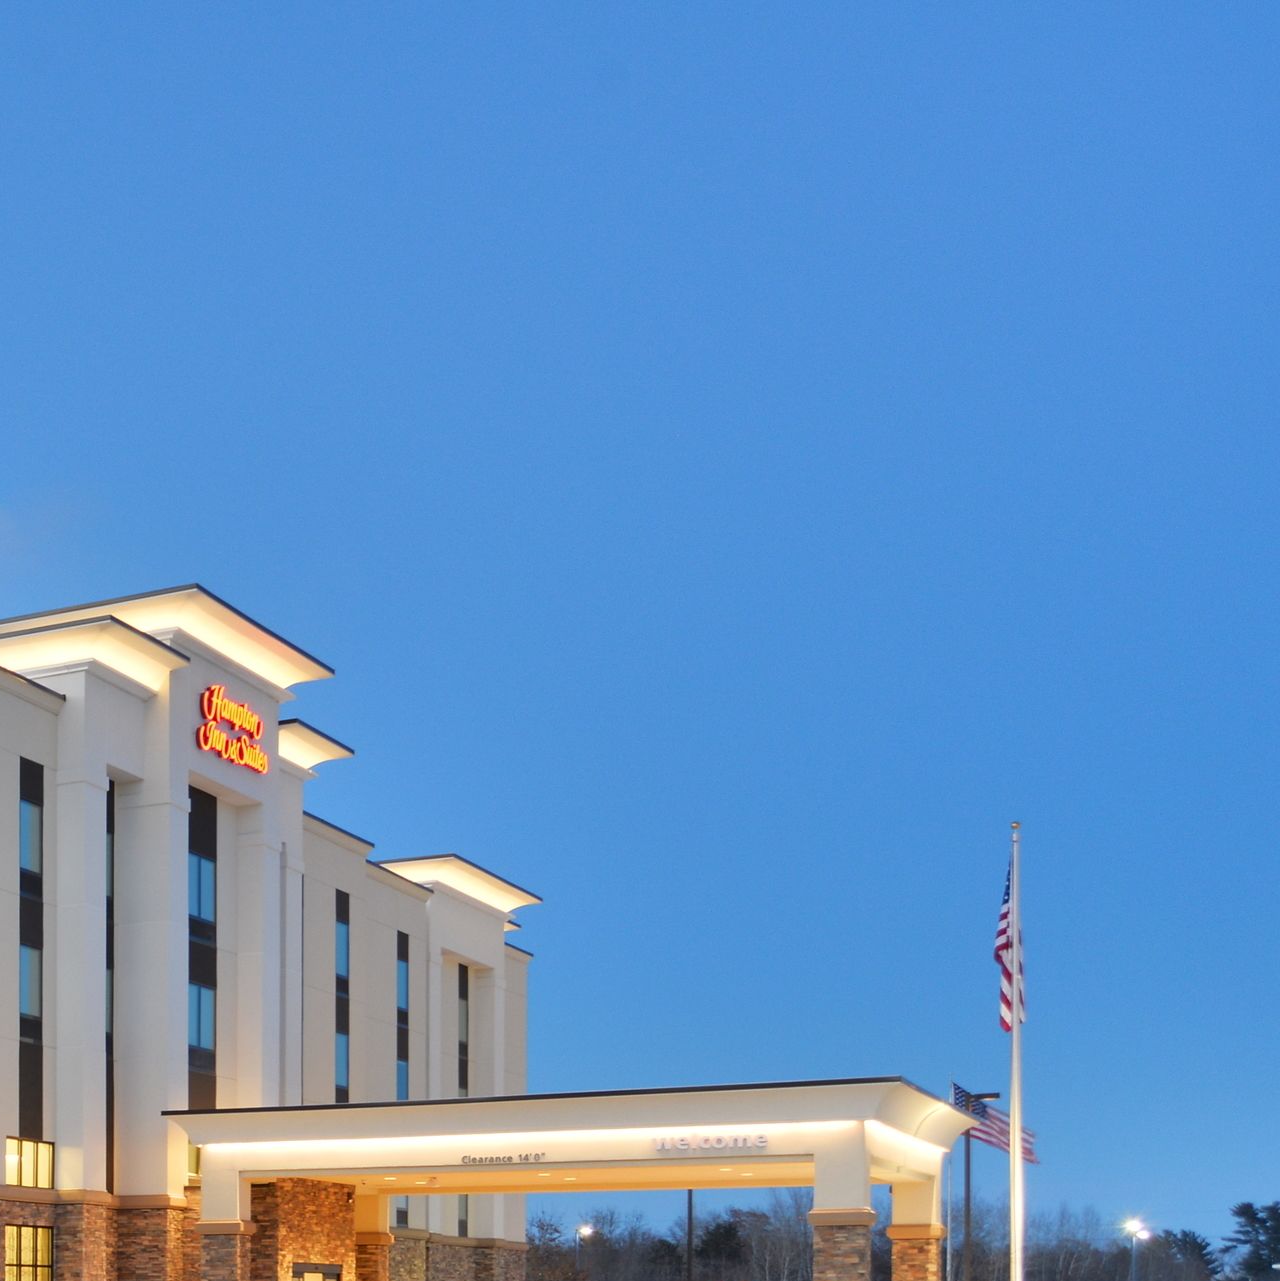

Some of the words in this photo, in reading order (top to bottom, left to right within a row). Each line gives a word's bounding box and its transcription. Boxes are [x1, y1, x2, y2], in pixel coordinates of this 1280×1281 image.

[201, 684, 263, 739] Hampton
[198, 721, 232, 758] Inn
[236, 735, 269, 774] Suites
[461, 1155, 513, 1164] Clearance
[654, 1134, 768, 1151] welcome
